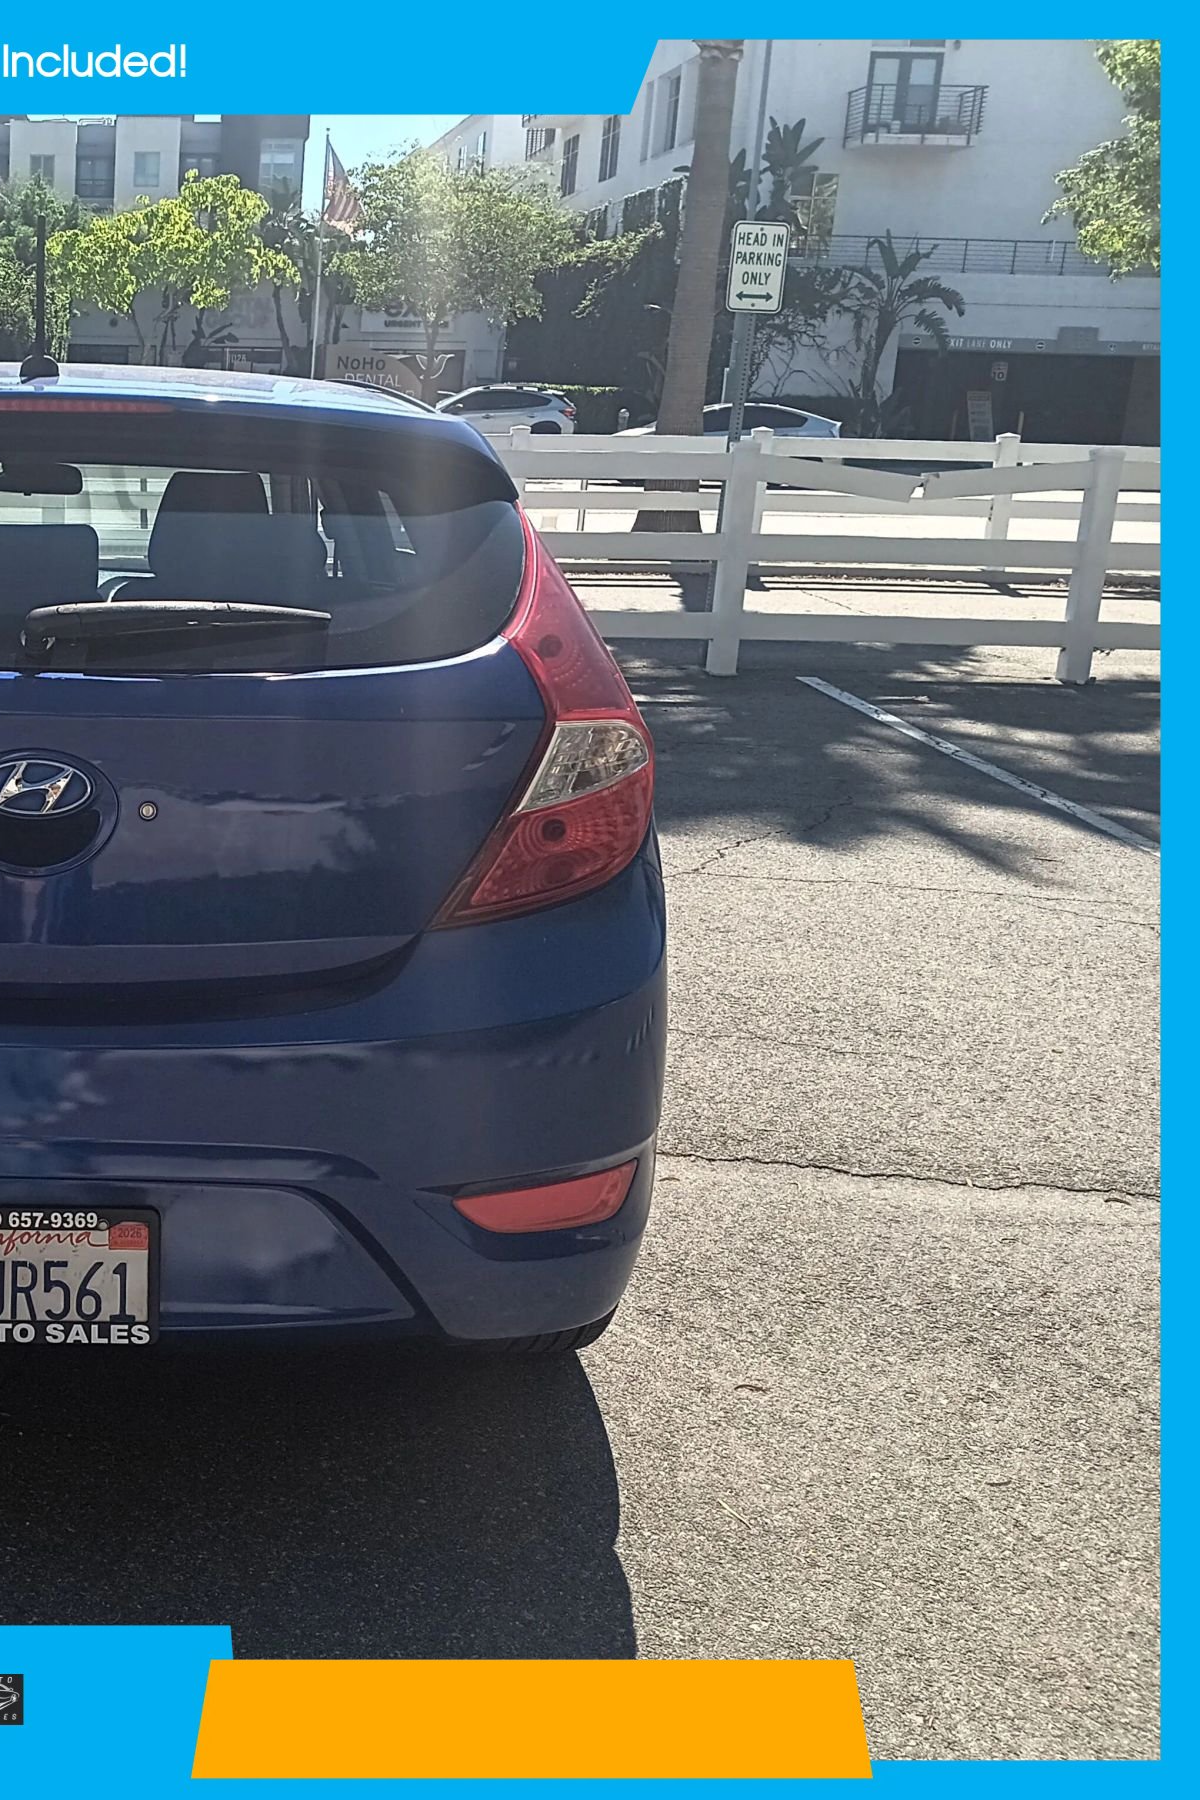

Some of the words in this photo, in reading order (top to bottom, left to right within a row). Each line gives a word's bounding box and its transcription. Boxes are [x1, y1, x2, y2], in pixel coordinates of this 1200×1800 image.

[737, 232, 768, 247] HEAD
[772, 233, 785, 247] IN
[735, 251, 782, 267] PARKING
[742, 271, 772, 286] ONLY
[948, 338, 964, 347] XIT
[989, 340, 1013, 349] ONLY
[337, 356, 386, 371] NoHo
[8, 1211, 98, 1229] 657-9369
[45, 1324, 150, 1345] SALES
